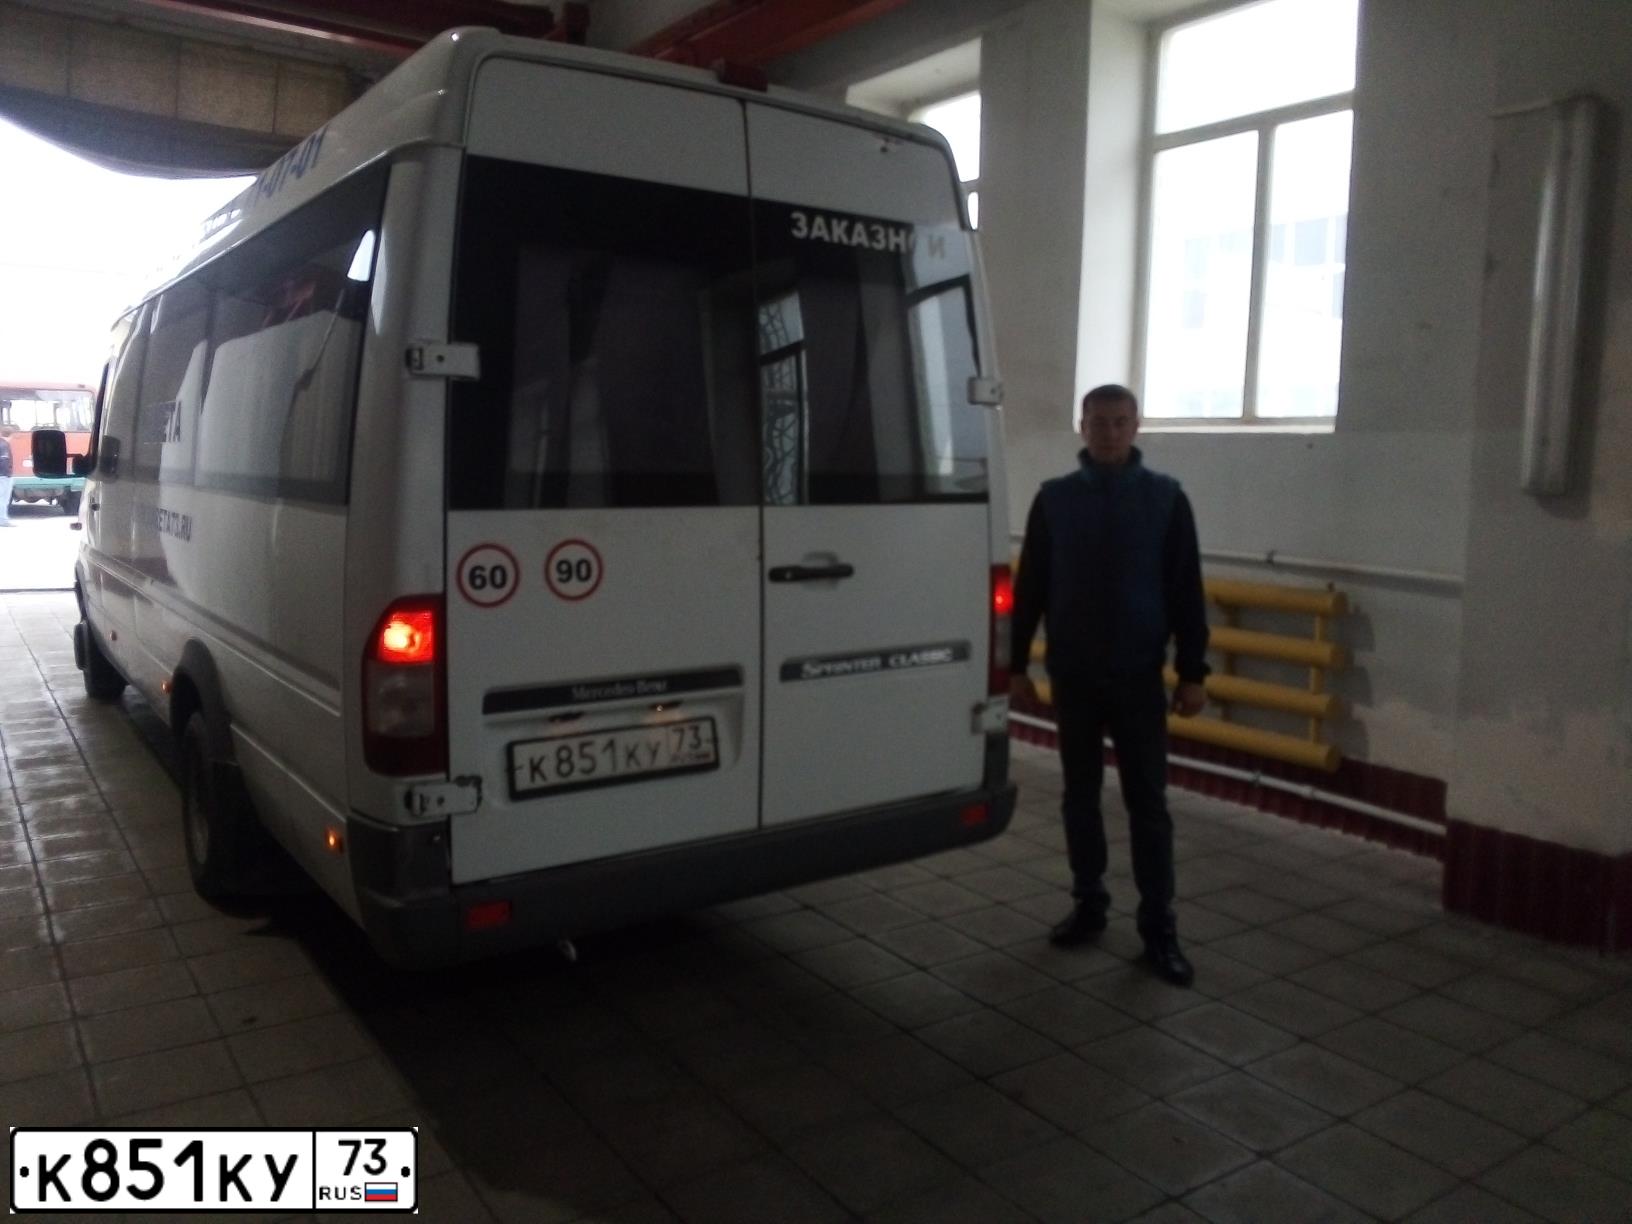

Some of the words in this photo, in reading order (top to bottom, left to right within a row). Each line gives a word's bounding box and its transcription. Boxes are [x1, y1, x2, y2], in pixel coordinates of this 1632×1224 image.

[468, 564, 507, 590] 60
[556, 557, 592, 583] 90
[671, 724, 703, 753] 73
